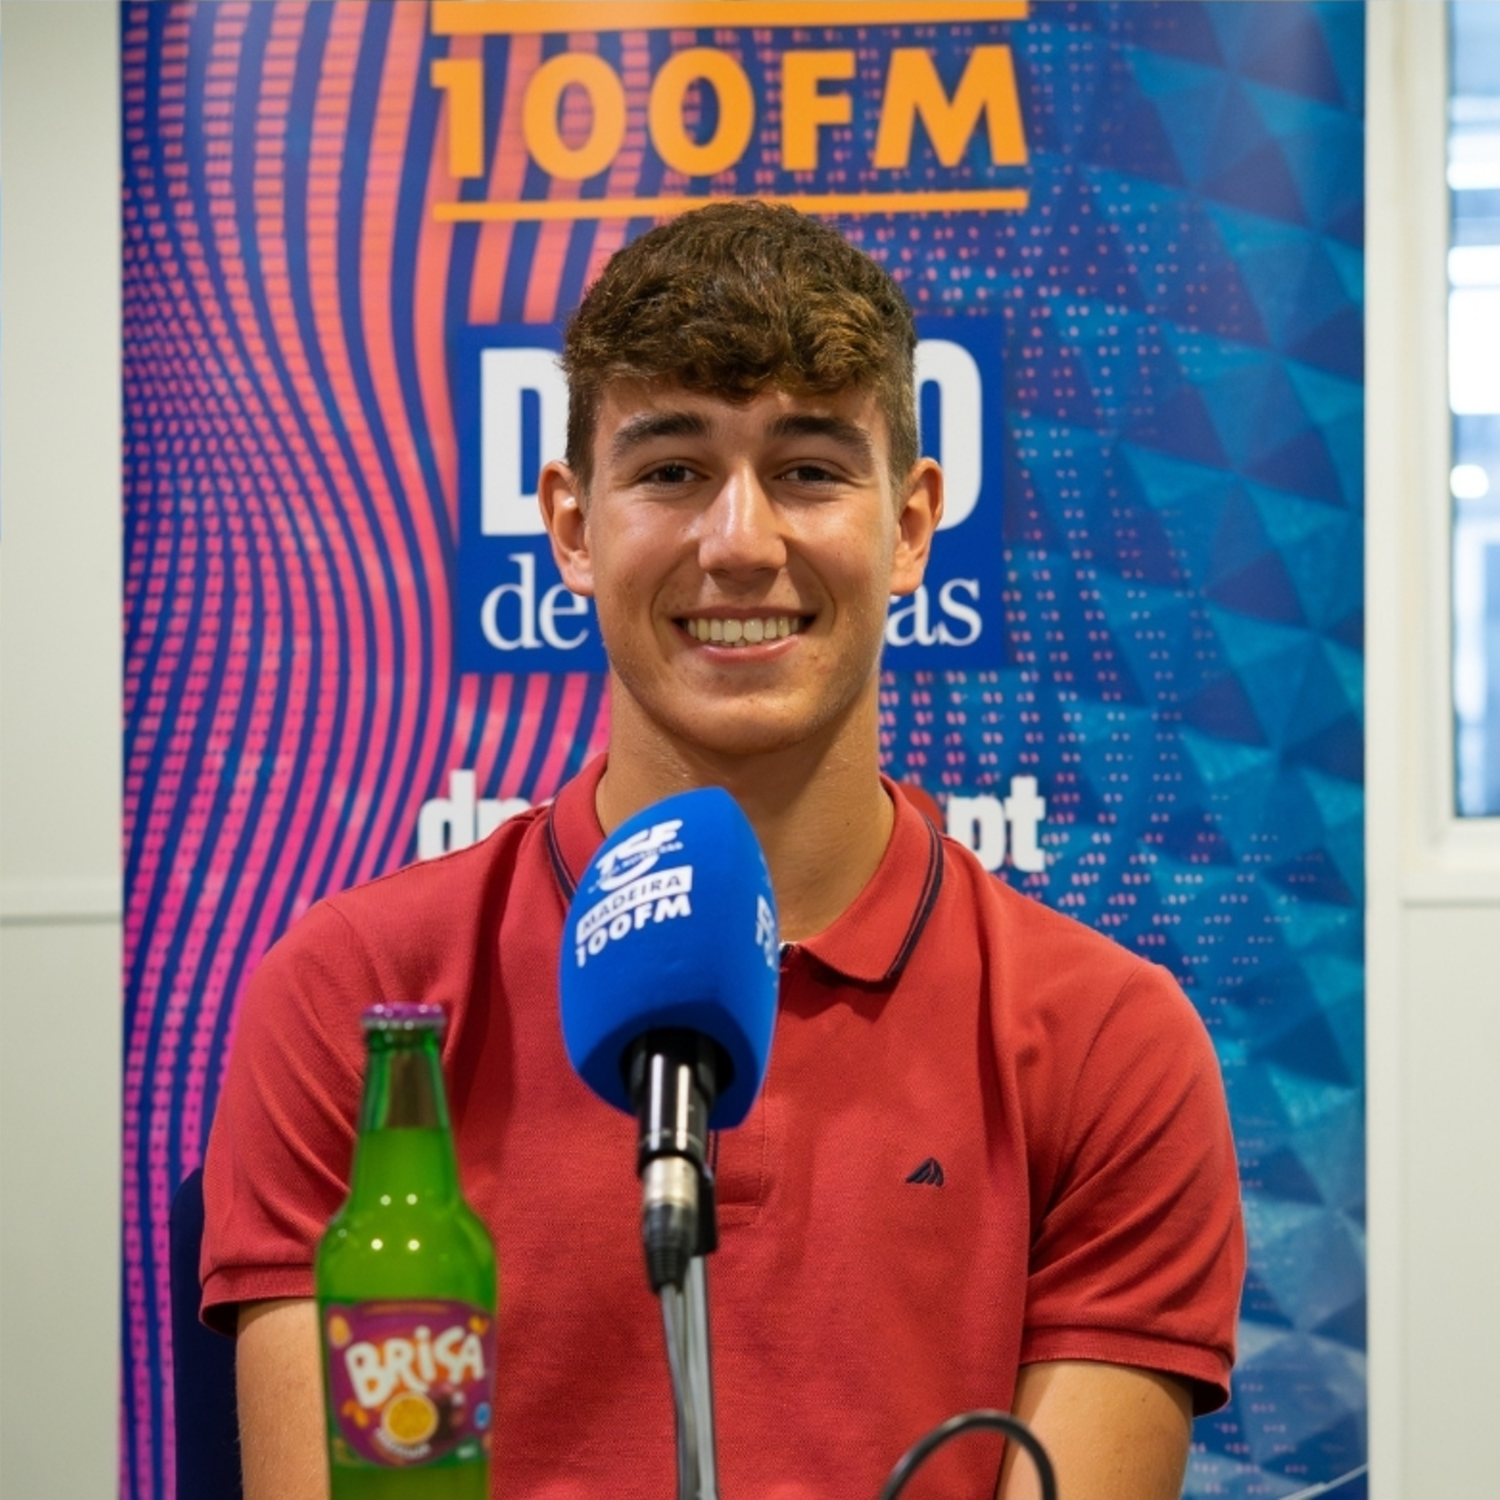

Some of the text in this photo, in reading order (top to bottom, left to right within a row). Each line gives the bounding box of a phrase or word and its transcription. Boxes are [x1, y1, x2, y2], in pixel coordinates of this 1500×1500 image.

[432, 45, 1028, 181] 100FM
[480, 552, 590, 650] de
[575, 894, 692, 968] 100FM
[581, 874, 681, 936] MADEIRA
